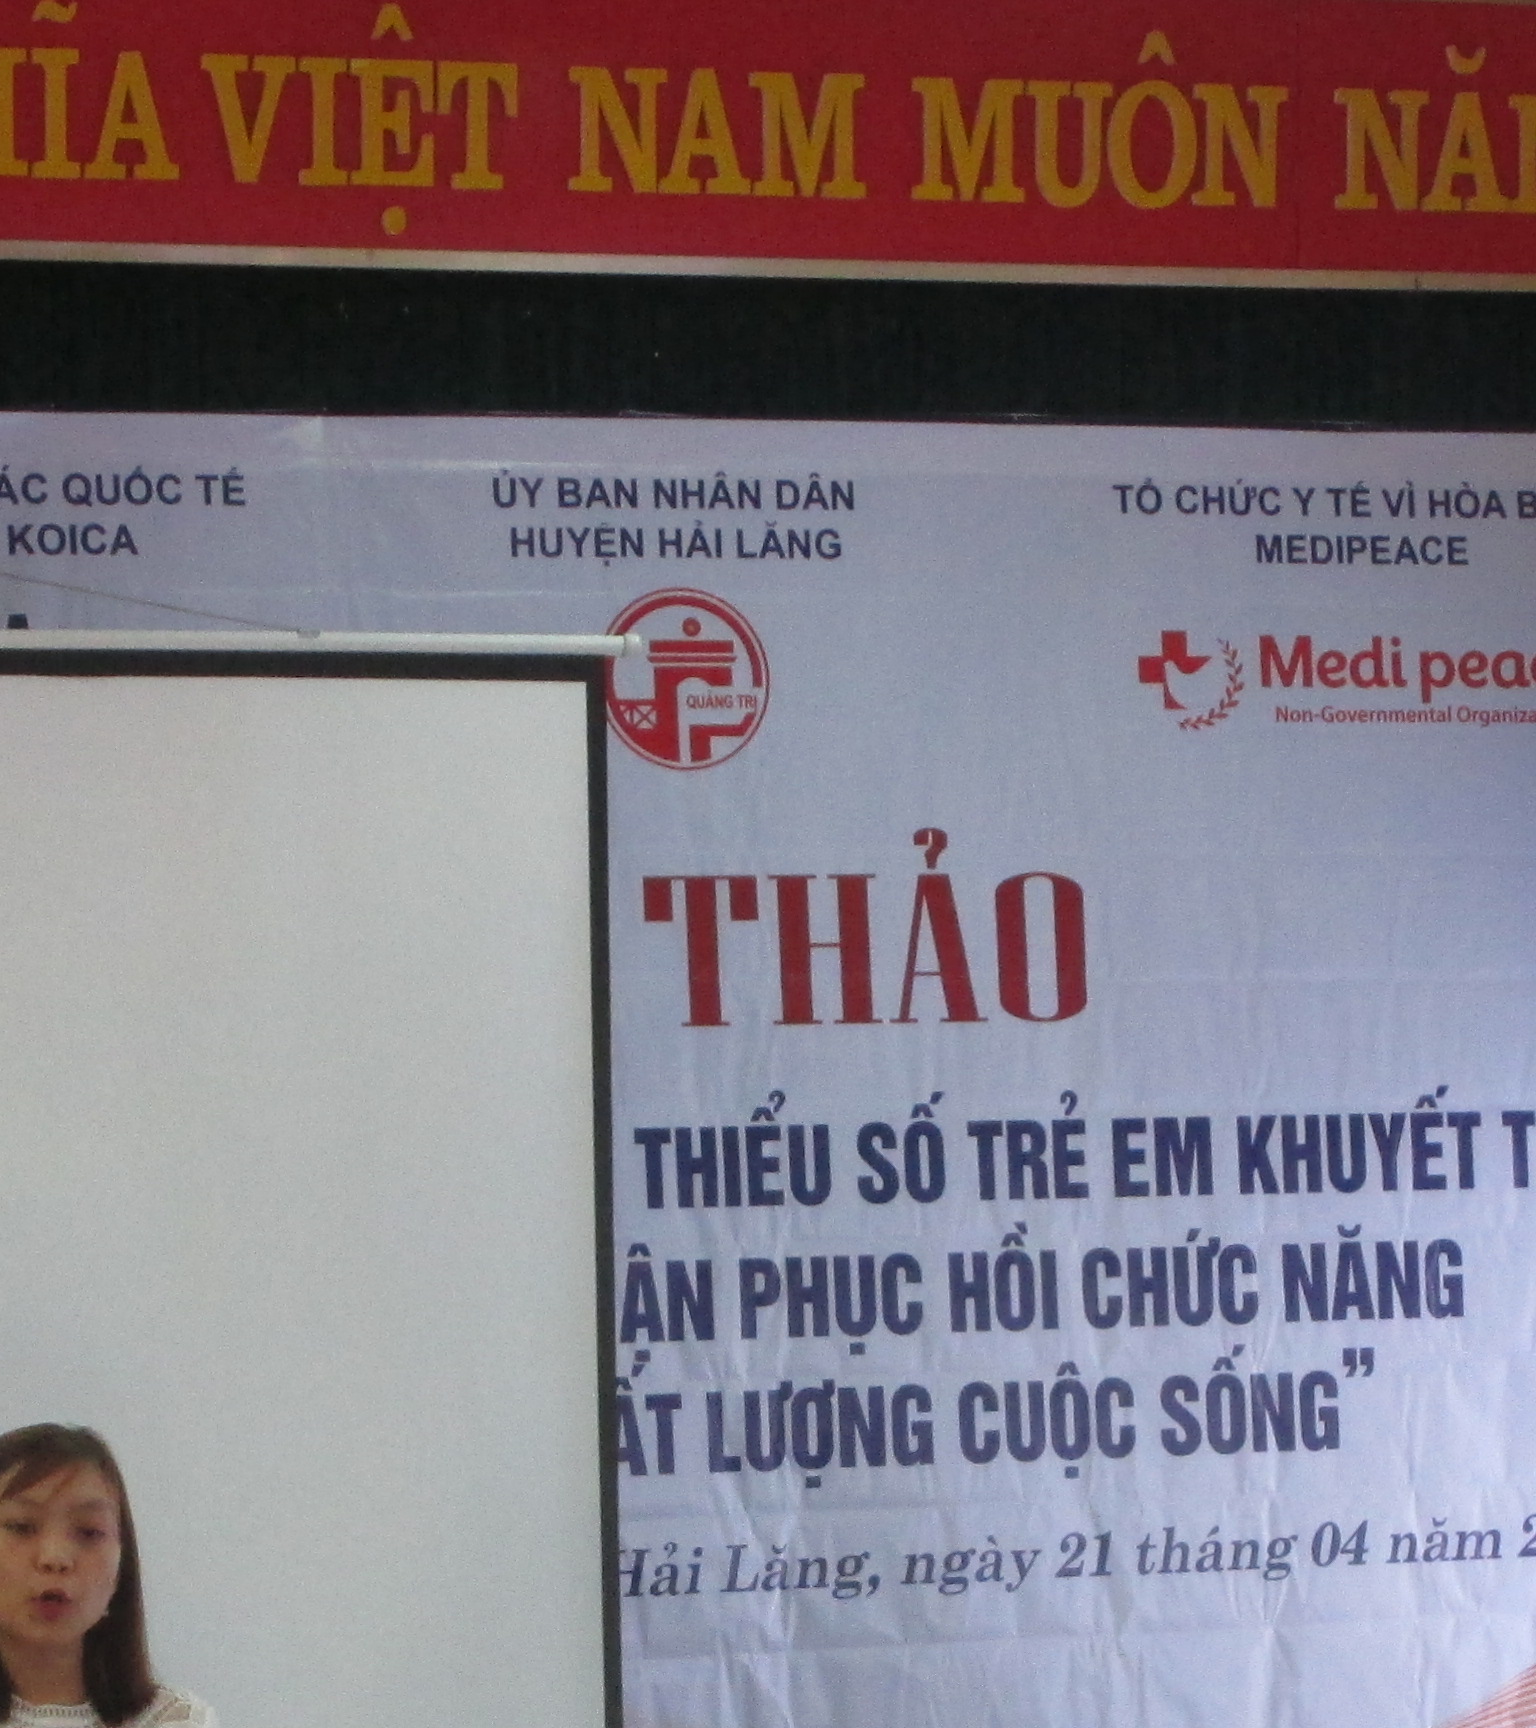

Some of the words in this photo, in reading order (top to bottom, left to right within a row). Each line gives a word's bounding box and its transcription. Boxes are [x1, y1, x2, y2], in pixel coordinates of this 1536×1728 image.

[201, 3, 518, 236] VIỆT
[567, 66, 866, 198] NAM
[911, 30, 1289, 208] MUÔN
[492, 468, 544, 510] ỦY
[556, 477, 638, 510] BAN
[653, 470, 762, 511] NHÂN
[775, 472, 855, 512] DÂN
[1175, 478, 1281, 517] CHỨC
[1293, 487, 1316, 518] Y
[1326, 480, 1371, 519] TẾ
[1382, 484, 1417, 520] VÌ
[1428, 484, 1507, 520] HÒA
[7, 523, 140, 556] KOICA
[510, 522, 645, 567] HUYỆN
[659, 519, 722, 560] HẢI
[736, 519, 843, 560] LĂNG
[1255, 534, 1470, 566] MEDIPEACE
[1275, 704, 1453, 725] Non-Governmental
[642, 826, 1088, 1027] THẢO
[634, 1090, 832, 1209] THIỂU
[856, 1091, 947, 1204] SỐ
[966, 1089, 1091, 1201] TRẺ
[1111, 1115, 1215, 1199] EM
[1235, 1084, 1482, 1196] KHUYẾT
[738, 1251, 924, 1355] PHỤC
[947, 1221, 1060, 1333] HỒI
[1081, 1227, 1260, 1330] CHỨC
[1281, 1224, 1465, 1322] NĂNG
[705, 1378, 935, 1489] LƯỢNG
[957, 1361, 1137, 1479] CUỘC
[719, 1543, 883, 1600] Lăng,
[899, 1535, 1043, 1596] ngày
[1054, 1531, 1115, 1579] 21
[1135, 1525, 1299, 1582] tháng
[1310, 1519, 1370, 1568] 04
[1386, 1516, 1503, 1564] năm
